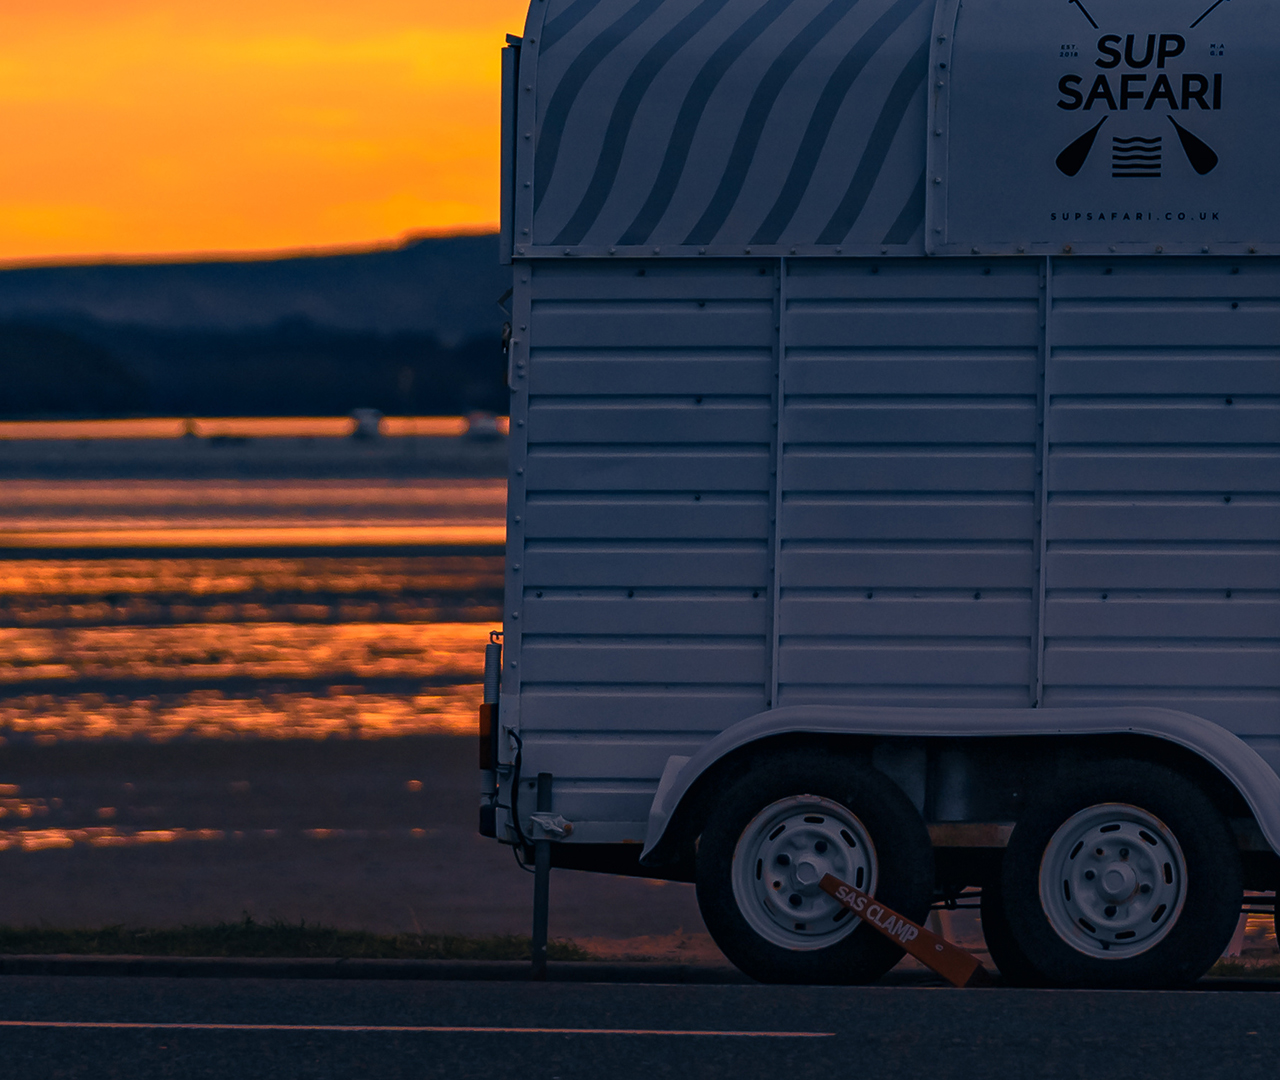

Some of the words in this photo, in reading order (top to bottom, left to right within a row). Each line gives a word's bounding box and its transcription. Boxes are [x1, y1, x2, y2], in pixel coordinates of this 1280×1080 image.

[1094, 33, 1186, 69] SUP
[1056, 73, 1223, 111] SAFARI
[1050, 212, 1220, 221] SUPSAFARI.CO.UK
[835, 885, 868, 912] SAS
[866, 904, 919, 944] CLAMP
